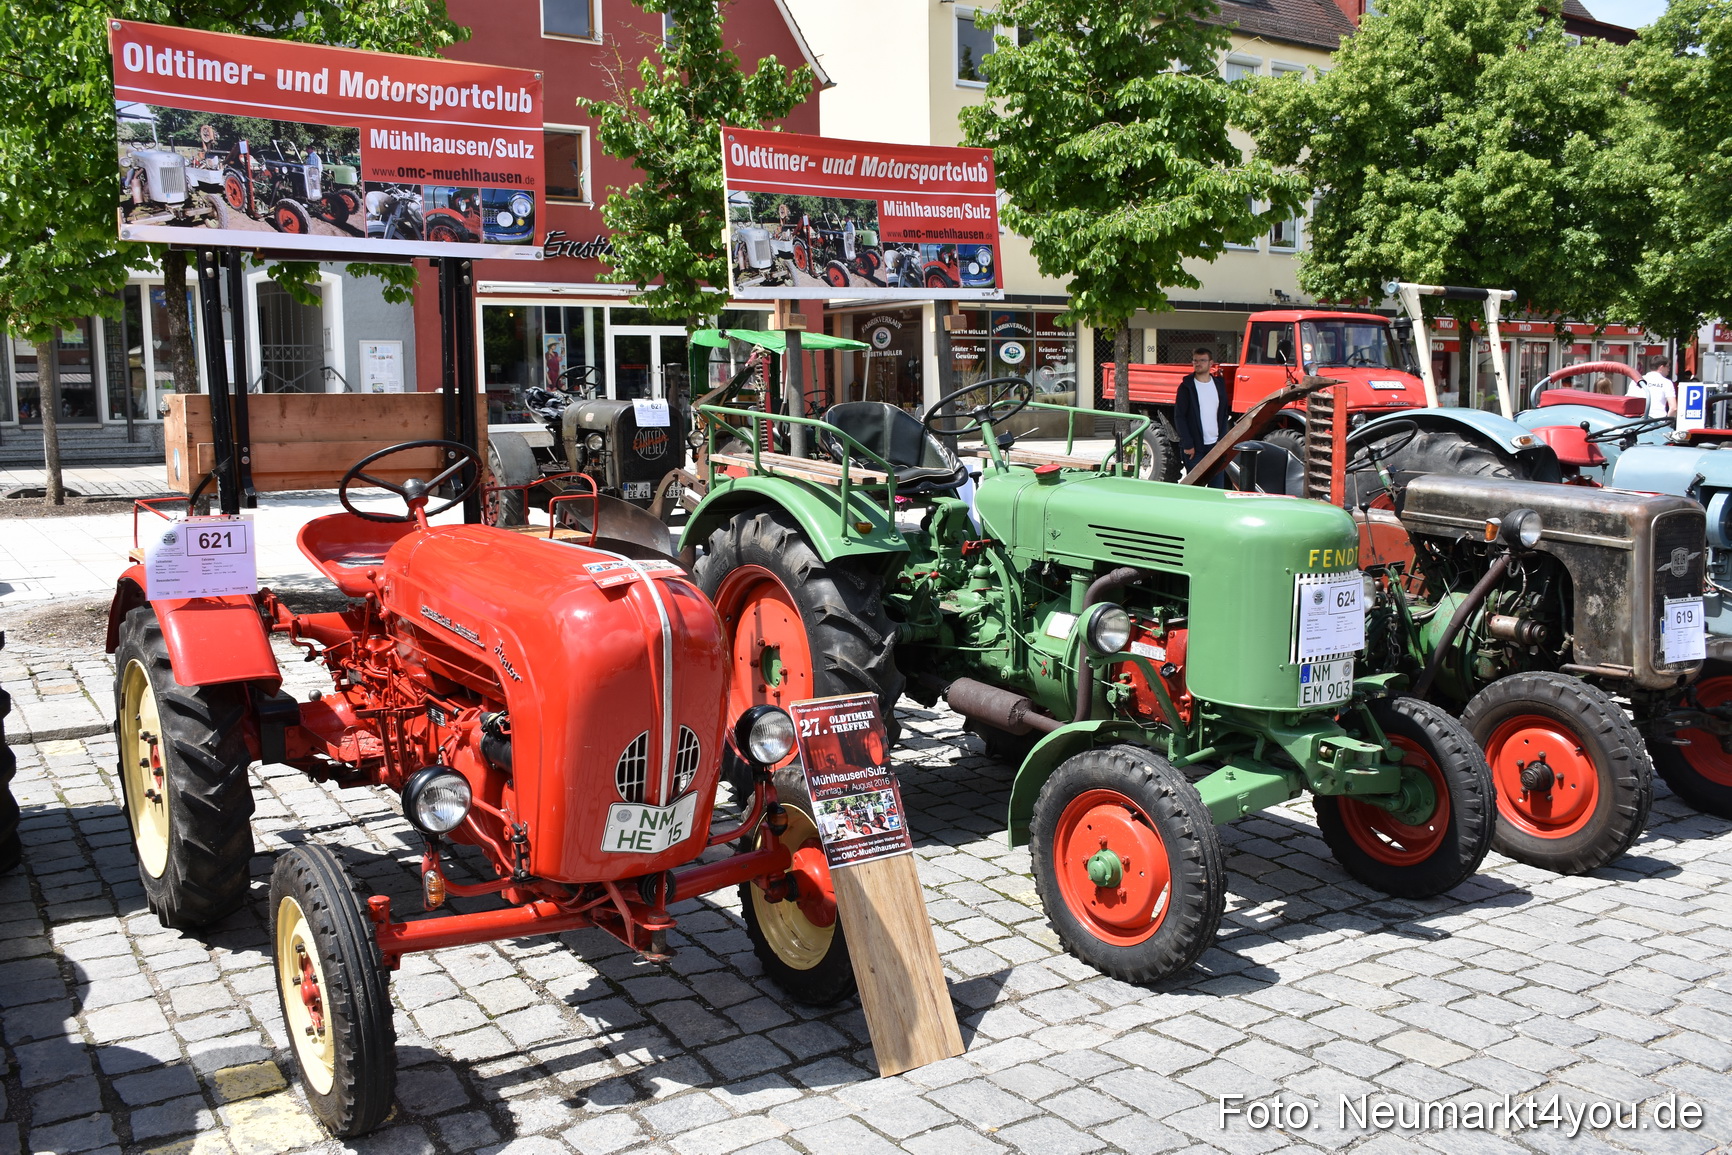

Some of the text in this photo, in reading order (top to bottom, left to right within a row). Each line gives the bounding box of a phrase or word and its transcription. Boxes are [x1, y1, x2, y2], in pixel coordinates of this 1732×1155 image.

[123, 41, 532, 114] Oldtimer- und Motorsportclub
[370, 128, 534, 160] Mühlhausen/Sulz
[730, 143, 988, 184] Oldtimer- und Motorsportclub
[372, 164, 535, 186] www.omc-muehlhausen.de
[883, 200, 991, 220] Mühlhausen/Sulz
[887, 228, 993, 241] www.omc-muehlhausen.de
[861, 315, 902, 333] FABRIKVERKAUF
[992, 322, 1032, 334] FABRIKVERKAUF
[1440, 320, 1453, 328] NKD
[955, 352, 978, 360] Gewürze
[1689, 389, 1701, 406] P
[628, 490, 648, 498] EE 41
[198, 531, 232, 549] 621
[1308, 546, 1359, 568] FENDT
[1337, 589, 1356, 608] 624
[1676, 610, 1693, 624] 619
[493, 637, 523, 682] Junior
[1312, 663, 1331, 684] NM
[1303, 680, 1350, 704] EM 903
[799, 710, 875, 738] 27. OLDTIMER
[830, 720, 870, 734] TREFFEN
[811, 766, 887, 786] Mühlhausen/Sulz
[815, 777, 890, 797] Sonntag, 7. August 2016
[639, 806, 676, 830] NM
[617, 821, 683, 851] HE 15
